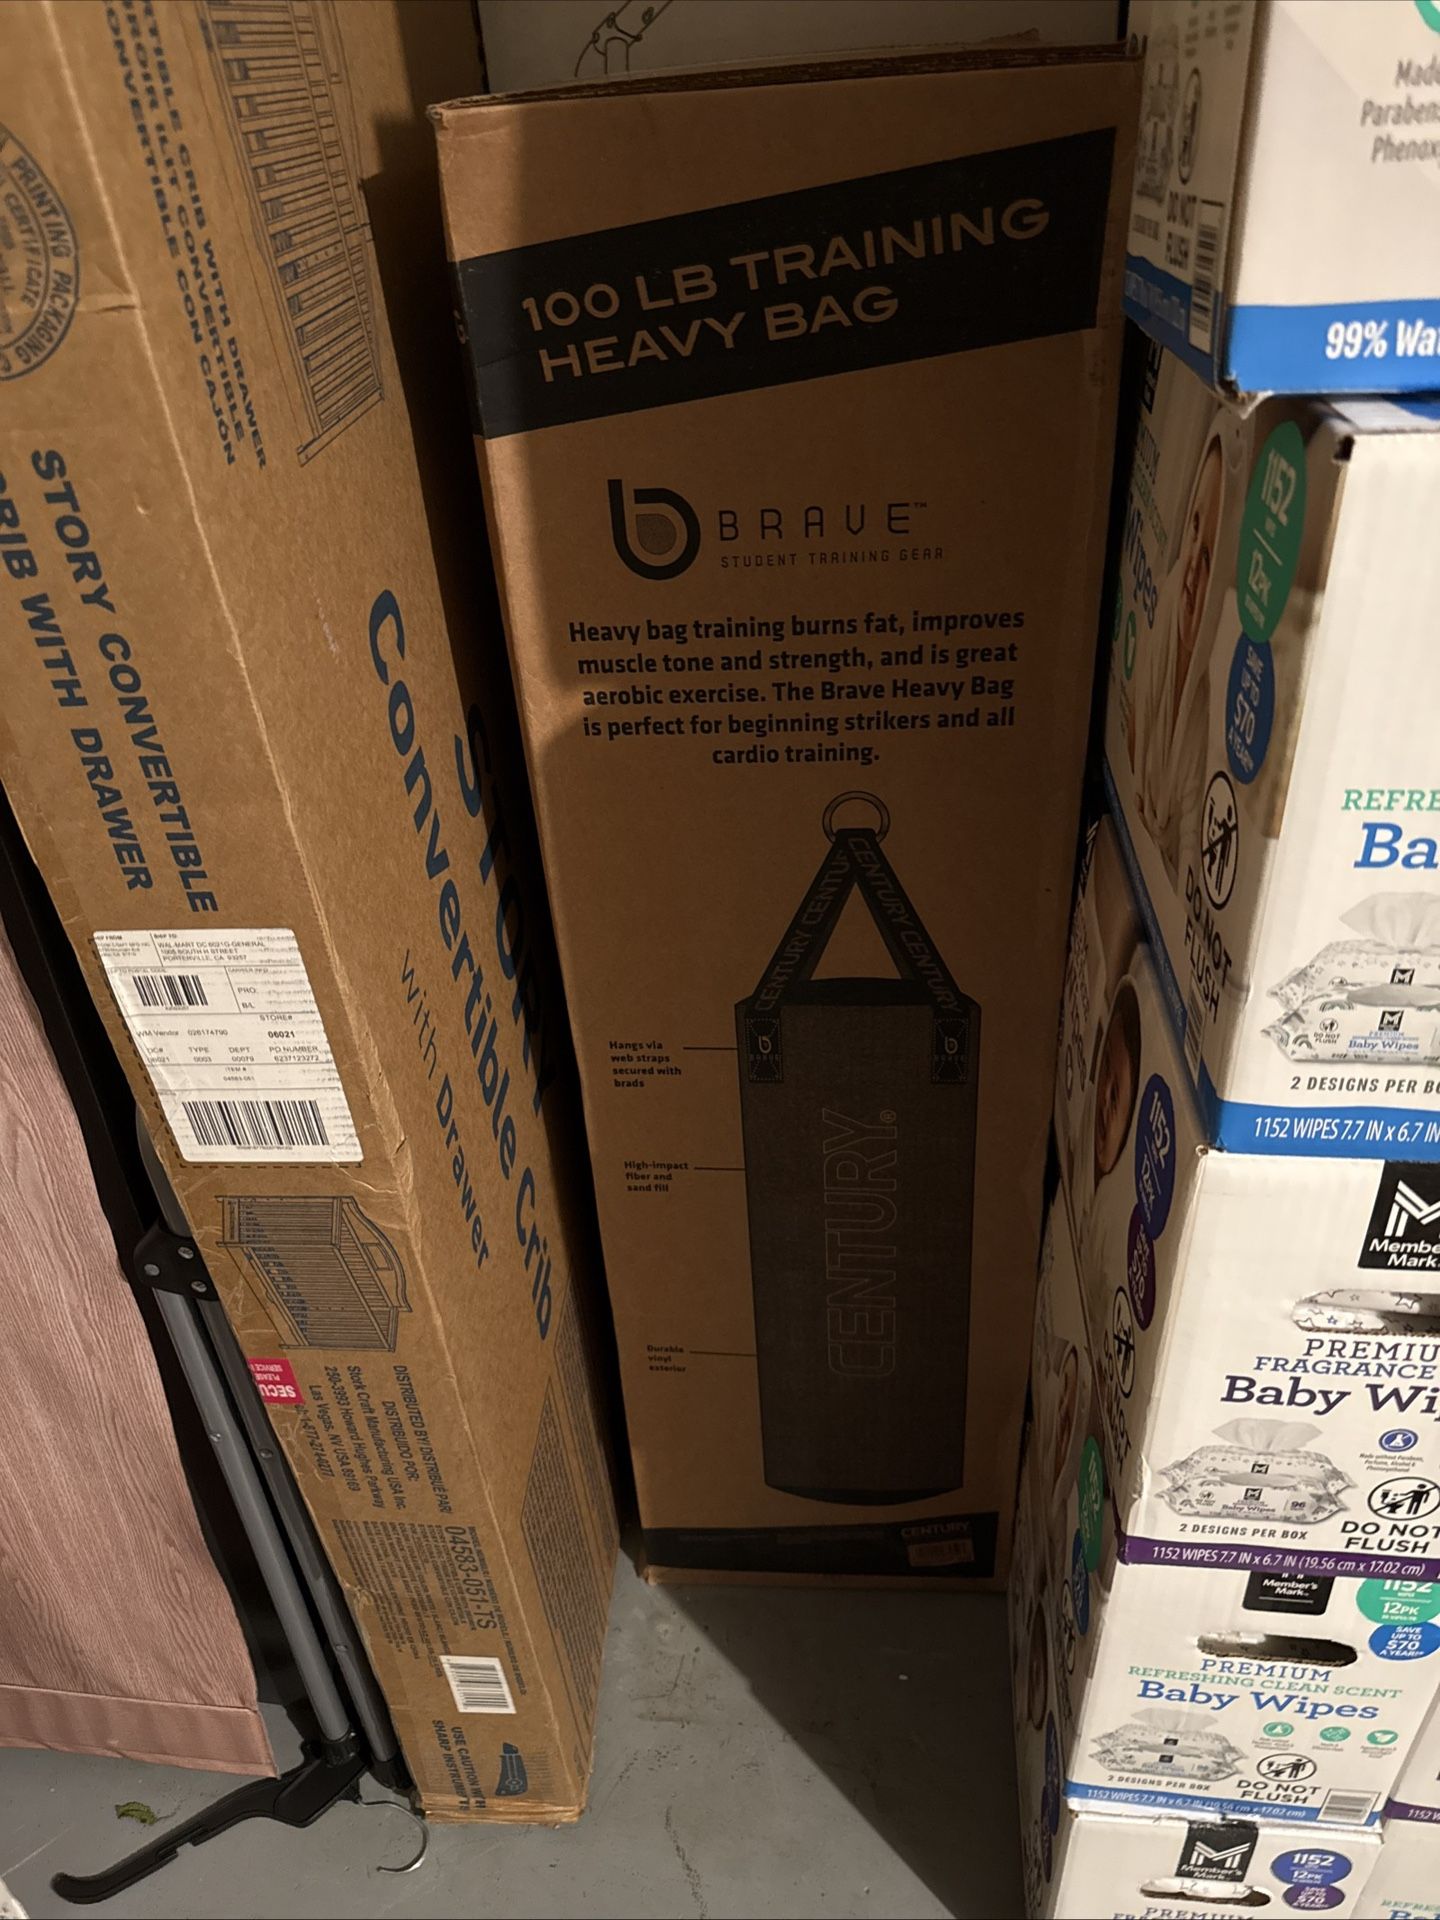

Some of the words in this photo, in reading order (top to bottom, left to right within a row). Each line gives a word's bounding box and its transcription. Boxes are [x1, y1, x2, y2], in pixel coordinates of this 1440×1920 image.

[12, 155, 71, 259] PRINTING
[521, 282, 620, 333] 100
[635, 263, 718, 310] LB
[729, 197, 1051, 293] TRAINING
[14, 269, 73, 366] PACKAGING
[177, 268, 203, 345] CON
[179, 143, 206, 229] CRIB
[203, 238, 231, 328] WITH
[227, 336, 266, 471] DRAWER
[177, 204, 245, 442] CONVERTIBLE
[538, 309, 747, 384] HEAVY
[764, 285, 899, 343] BAG
[1396, 318, 1440, 358] Wa
[1325, 320, 1388, 360] 99%
[1260, 448, 1298, 527] 1152
[721, 552, 798, 569] STUDENT
[808, 548, 891, 567] TRAINING
[899, 546, 944, 562] GEAR
[1124, 497, 1159, 630] Wipes
[568, 620, 641, 646] Heavy
[646, 618, 689, 645] bag
[692, 615, 785, 643] training
[791, 613, 858, 637] burns
[864, 610, 906, 638] fat,
[912, 609, 1026, 638] improves
[577, 652, 657, 675] muscle
[662, 650, 714, 673] tone
[720, 649, 762, 672] and
[768, 646, 874, 674] strength,
[880, 644, 924, 668] and
[929, 642, 951, 666] is
[955, 641, 1019, 669] great
[0, 470, 38, 579] RIB
[20, 592, 89, 709] WITH
[70, 727, 154, 892] DRAWER
[31, 448, 117, 614] STORY
[98, 632, 219, 914] CONVERTIBLE
[582, 684, 663, 707] aerobic
[668, 682, 767, 705] exercise.
[772, 680, 816, 703] The
[820, 679, 885, 702] Brave
[891, 676, 965, 703] Heavy
[970, 675, 1014, 701] Bag
[583, 716, 602, 738] is
[606, 714, 685, 742] perfect
[689, 713, 723, 736] for
[727, 711, 840, 738] beginning
[844, 709, 931, 732] strikers
[935, 707, 981, 729] and
[985, 706, 1016, 728] all
[712, 743, 781, 765] cardio
[784, 742, 881, 767] training.
[848, 837, 915, 928] CENTURY
[454, 703, 562, 1117] STORY
[368, 588, 518, 1182] Convertible
[515, 1166, 556, 1342] Crib
[1203, 910, 1233, 988] NOT
[756, 928, 814, 1012] CENTURY
[899, 929, 963, 1014] CENTURY
[1184, 916, 1220, 1025] FLUSH
[268, 1030, 296, 1039] 06021
[608, 1039, 643, 1052] Hangs
[646, 1039, 663, 1051] via
[1348, 1040, 1379, 1051] Baby
[1381, 1041, 1420, 1051] Wipes
[610, 1052, 634, 1064] web
[636, 1053, 671, 1065] straps
[612, 1065, 655, 1076] secured
[657, 1065, 682, 1076] with
[614, 1077, 645, 1089] brads
[1290, 1076, 1302, 1090] 2
[1306, 1076, 1380, 1093] DESIGNS
[1384, 1078, 1418, 1094] PER
[1254, 1116, 1290, 1139] 1152
[1292, 1117, 1341, 1140] WIPES
[1341, 1119, 1365, 1141] 7.7
[1365, 1120, 1385, 1142] IN
[1384, 1125, 1397, 1142] x
[1397, 1121, 1424, 1143] 6.7
[437, 1080, 492, 1270] Drawer
[623, 1159, 689, 1172] High-impact
[625, 1171, 650, 1182] fiber
[652, 1172, 673, 1182] and
[626, 1183, 651, 1193] sand
[653, 1182, 670, 1193] fill
[647, 1344, 685, 1354] Durable
[647, 1354, 673, 1364] vinyl
[347, 1365, 367, 1391] Stork
[648, 1363, 687, 1374] exterior
[1253, 1356, 1438, 1381] FRAGRANCE
[309, 1384, 324, 1402] Las
[357, 1390, 375, 1415] Craft
[393, 1365, 425, 1430] DISTRIBUTED
[1220, 1374, 1352, 1416] Baby
[1365, 1383, 1440, 1423] Wi
[365, 1414, 395, 1476] Manufacturing
[382, 1400, 413, 1461] DISTRIBUIDO
[340, 1407, 358, 1440] Howard
[353, 1438, 373, 1475] Hughes
[368, 1473, 386, 1510] Parkway
[1178, 1523, 1187, 1533] 2
[1191, 1523, 1248, 1537] DESIGNS
[1251, 1528, 1277, 1539] PER
[1282, 1529, 1309, 1541] BOX
[1341, 1520, 1381, 1535] DO
[1152, 1546, 1180, 1560] 1152
[1182, 1548, 1218, 1563] WIPES
[1219, 1550, 1237, 1563] 7.7
[1238, 1551, 1252, 1564] IN
[1251, 1556, 1261, 1565] x
[1263, 1552, 1281, 1566] 6.7
[1283, 1554, 1298, 1567] IN
[1298, 1554, 1336, 1571] (19.56
[1336, 1560, 1356, 1572] cm
[1357, 1562, 1368, 1573] x
[1368, 1560, 1400, 1574] 17.02
[1400, 1561, 1427, 1577] cm)
[1344, 1537, 1431, 1555] FLUSH
[445, 1525, 498, 1630] 04583-051-TS
[1262, 1577, 1319, 1591] Member's
[1382, 1601, 1421, 1616] 12PK
[1385, 1640, 1421, 1651] $70
[1395, 1626, 1423, 1634] SAVE
[1128, 1665, 1254, 1688] REFRESHING
[1260, 1679, 1329, 1695] CLEAN
[1332, 1685, 1403, 1699] SCENT
[1200, 1658, 1332, 1683] PREMIUM
[1137, 1679, 1240, 1711] Baby
[1250, 1691, 1380, 1720] Wipes
[432, 1719, 451, 1753] SHARP
[452, 1726, 467, 1746] USE
[458, 1747, 480, 1789] CAUTION
[1117, 1775, 1163, 1787] DESIGNS
[1166, 1780, 1187, 1789] PER
[1189, 1782, 1211, 1792] BOX
[1236, 1779, 1268, 1790] DO
[1275, 1781, 1322, 1796] NOT
[1240, 1790, 1310, 1805] FLUSH
[1292, 1852, 1337, 1867] 1152
